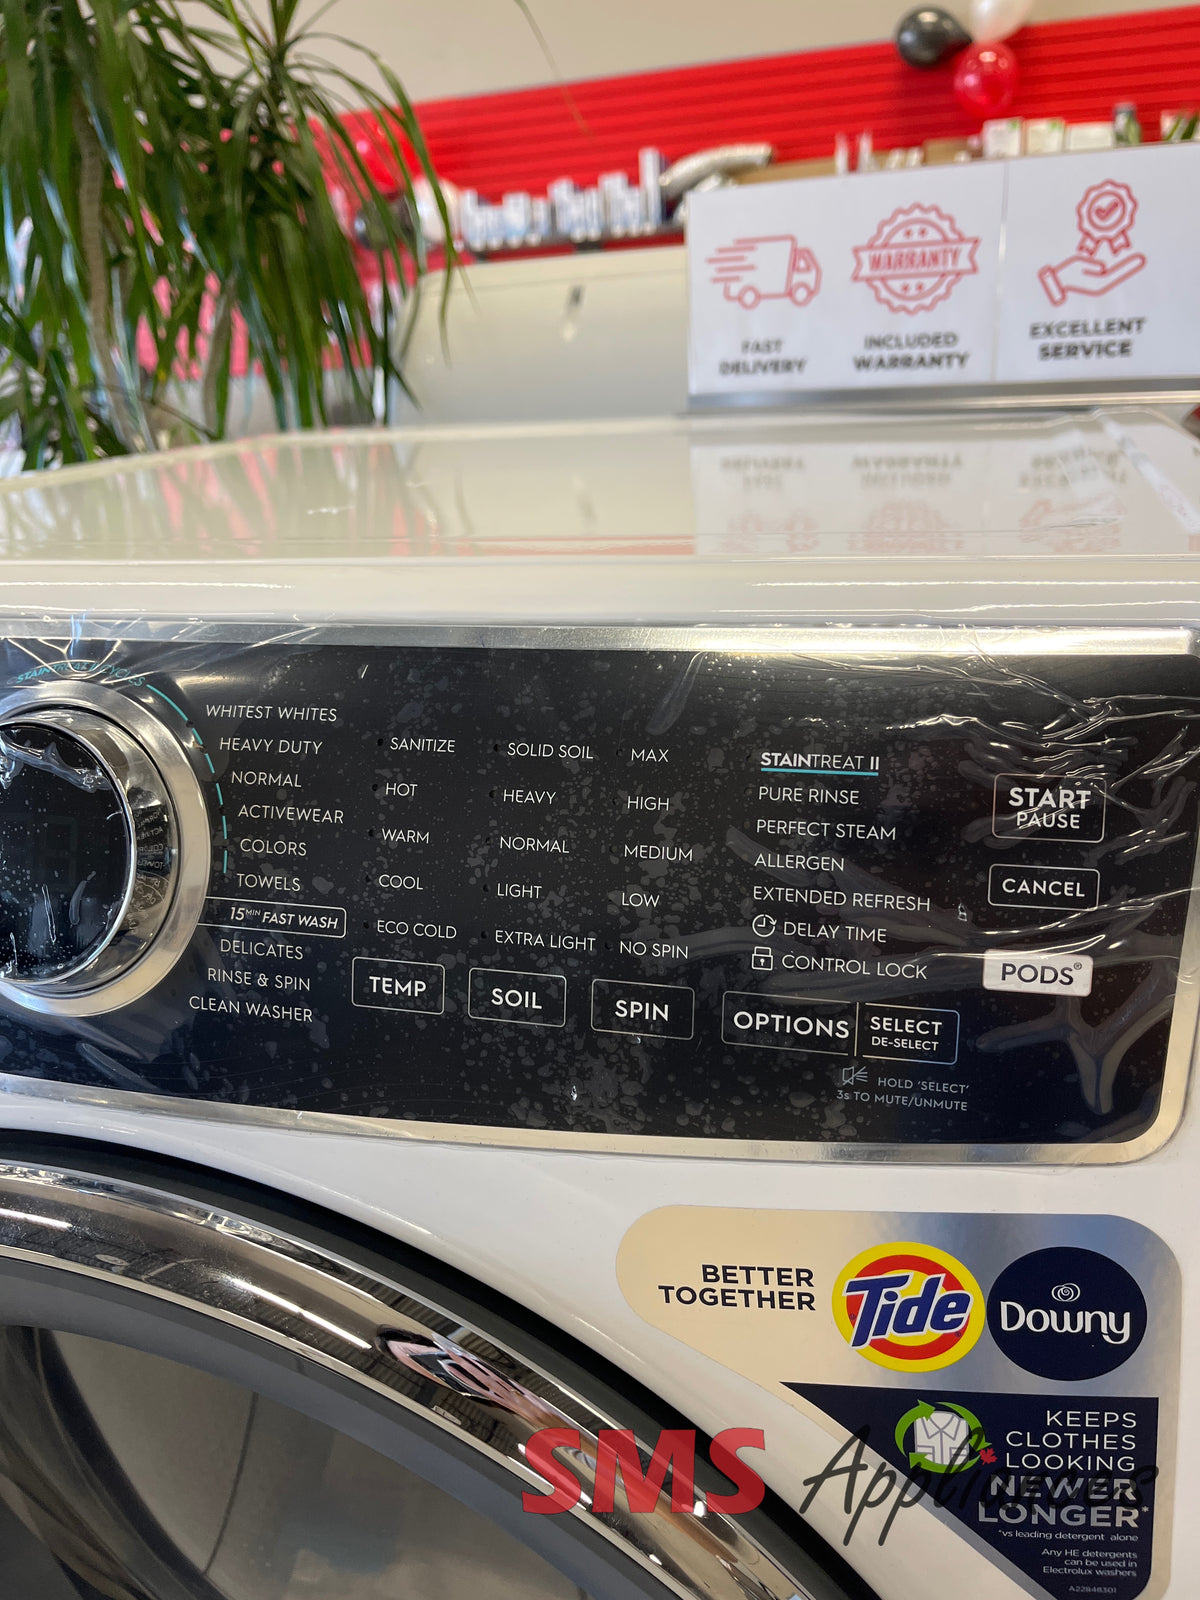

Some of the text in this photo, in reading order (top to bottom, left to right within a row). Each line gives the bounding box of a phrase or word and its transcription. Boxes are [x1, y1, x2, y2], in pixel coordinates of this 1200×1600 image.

[870, 250, 962, 272] WARRANTY
[1030, 318, 1145, 339] EXCELLENT
[741, 339, 783, 354] FAST
[864, 331, 959, 349] INCLUDED
[1039, 341, 1133, 360] SERVICE
[719, 359, 807, 375] DELIVERY
[854, 352, 970, 370] WARRANTY
[206, 704, 338, 722] WHITEST WHITES
[220, 737, 323, 755] HEAVY DUTY
[390, 737, 456, 753] SANITIZE
[507, 742, 594, 760] SOLID SOIL
[631, 748, 669, 763] MAX
[760, 752, 880, 771] STAINTREAT II
[231, 771, 302, 788] NORMAL
[385, 782, 418, 797] HOT
[503, 789, 557, 805] HEAVY
[758, 786, 860, 805] PURE RINSE
[1008, 786, 1091, 811] START
[627, 795, 670, 811] HIGH
[238, 805, 344, 824] ACTIVEWEAR
[1016, 811, 1081, 830] PAUSE
[381, 828, 430, 844] WARM
[756, 819, 897, 841] PERFECT STEAM
[240, 838, 307, 857] COLORS
[500, 836, 570, 854] NORMAL
[624, 844, 693, 862] MEDIUM
[754, 853, 845, 872] ALLERGEN
[236, 873, 301, 892] TOWELS
[378, 874, 424, 891] COOL
[497, 883, 543, 899] LIGHT
[1002, 877, 1085, 898] CANCEL
[621, 892, 660, 908] LOW
[753, 886, 931, 912] EXTENDED REFRESH
[262, 911, 295, 925] FAST
[298, 915, 338, 929] WASH
[377, 919, 457, 939] ECO COLD
[495, 930, 596, 951] EXTRA LIGHT
[783, 921, 887, 943] DELAY TIME
[220, 939, 304, 960] DELICATES
[620, 941, 689, 959] NO SPIN
[781, 954, 928, 980] CONTROL LOCK
[207, 968, 311, 991] RINSE & SPIN
[369, 976, 427, 997] TEMP
[491, 988, 543, 1009] SOIL
[189, 996, 313, 1023] CLEAN WASHER
[615, 1000, 670, 1022] SPIN
[733, 1011, 850, 1039] OPTIONS
[870, 1015, 943, 1036] SELECT
[871, 1036, 939, 1052] DE-SELECT
[877, 1077, 913, 1090] HOLD
[853, 1091, 871, 1102] TO
[874, 1092, 968, 1112] MUTE/UNMUTE
[702, 1264, 815, 1288] BETTER
[658, 1285, 817, 1312] TOGETHER
[843, 1272, 975, 1348] Tide
[1000, 1300, 1131, 1345] Downy
[1046, 1410, 1137, 1429] KEEPS
[1006, 1431, 1136, 1450] CLOTHES
[1006, 1452, 1135, 1472] LOOKING
[990, 1474, 1137, 1501] NEWER
[1015, 1530, 1053, 1540] leading
[1055, 1532, 1105, 1541] detergent
[1110, 1533, 1139, 1541] alone
[1041, 1548, 1138, 1559] Any HE detergents
[1043, 1565, 1137, 1577] Electrolux washers
[1101, 1559, 1126, 1567] used
[1128, 1560, 1137, 1568] in
